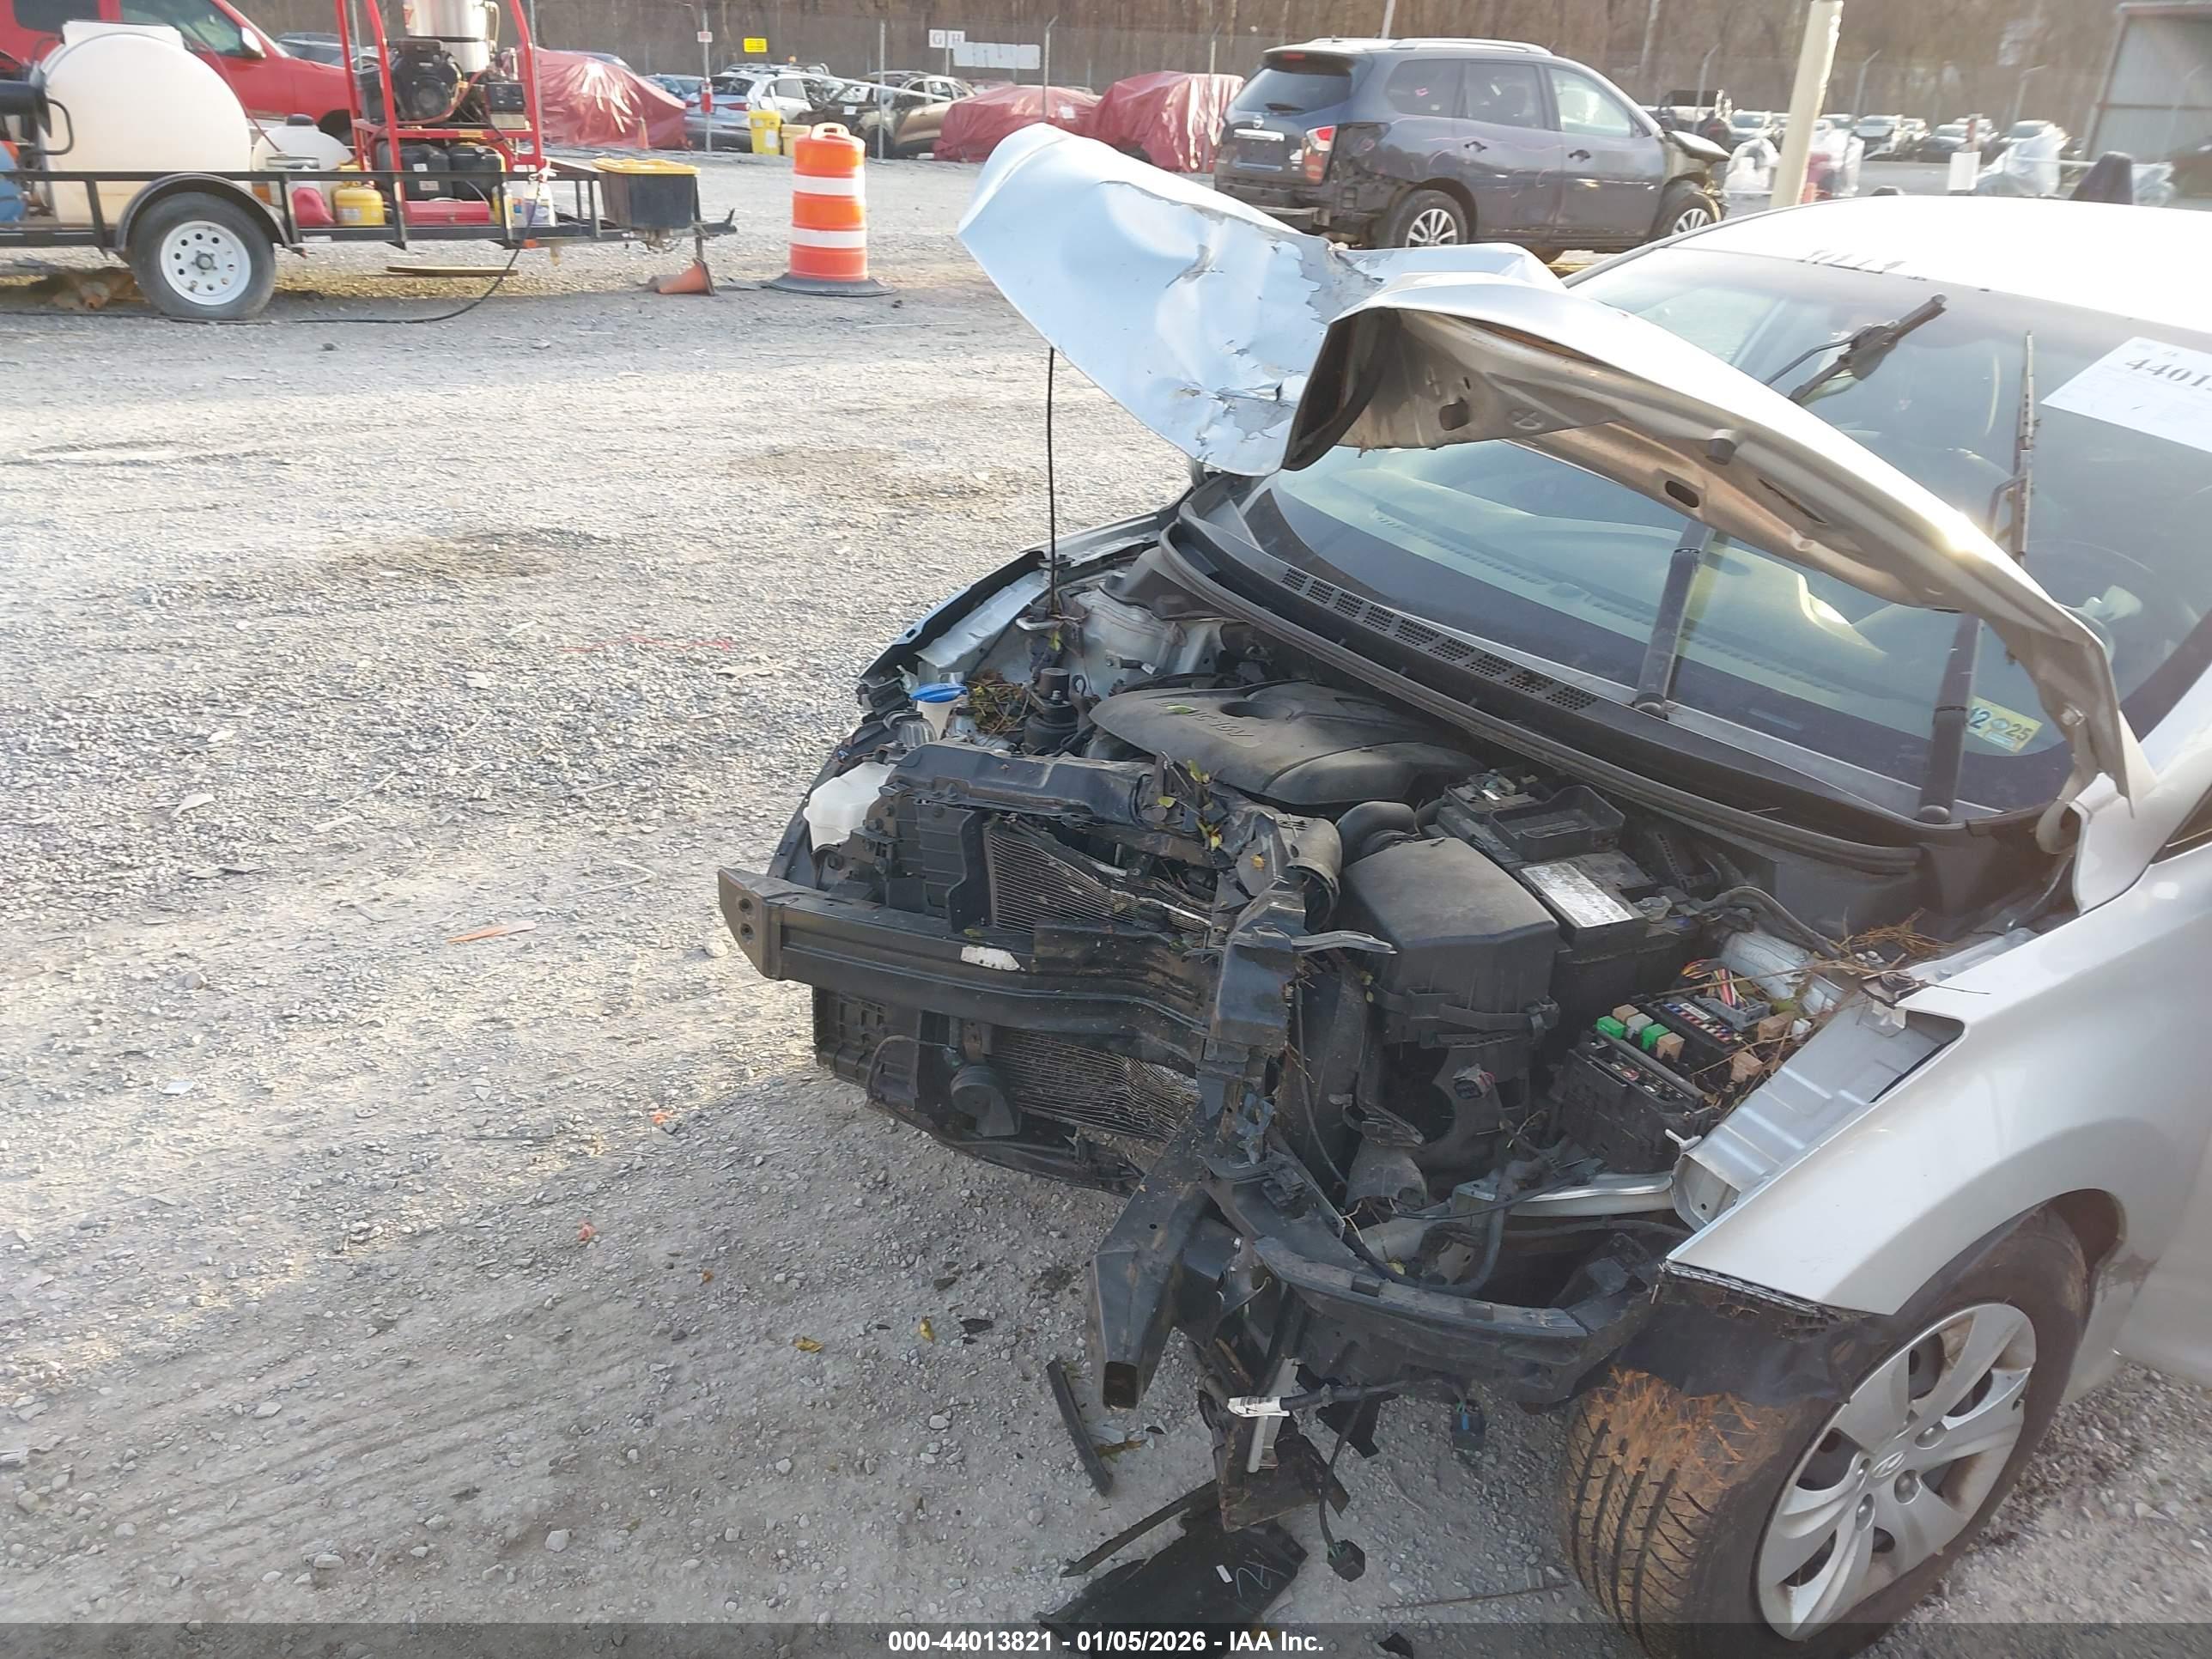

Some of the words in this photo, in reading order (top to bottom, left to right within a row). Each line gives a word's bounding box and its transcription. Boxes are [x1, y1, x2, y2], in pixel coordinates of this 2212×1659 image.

[933, 33, 943, 44] G
[2124, 358, 2212, 392] 4401
[2005, 723, 2033, 741] 25
